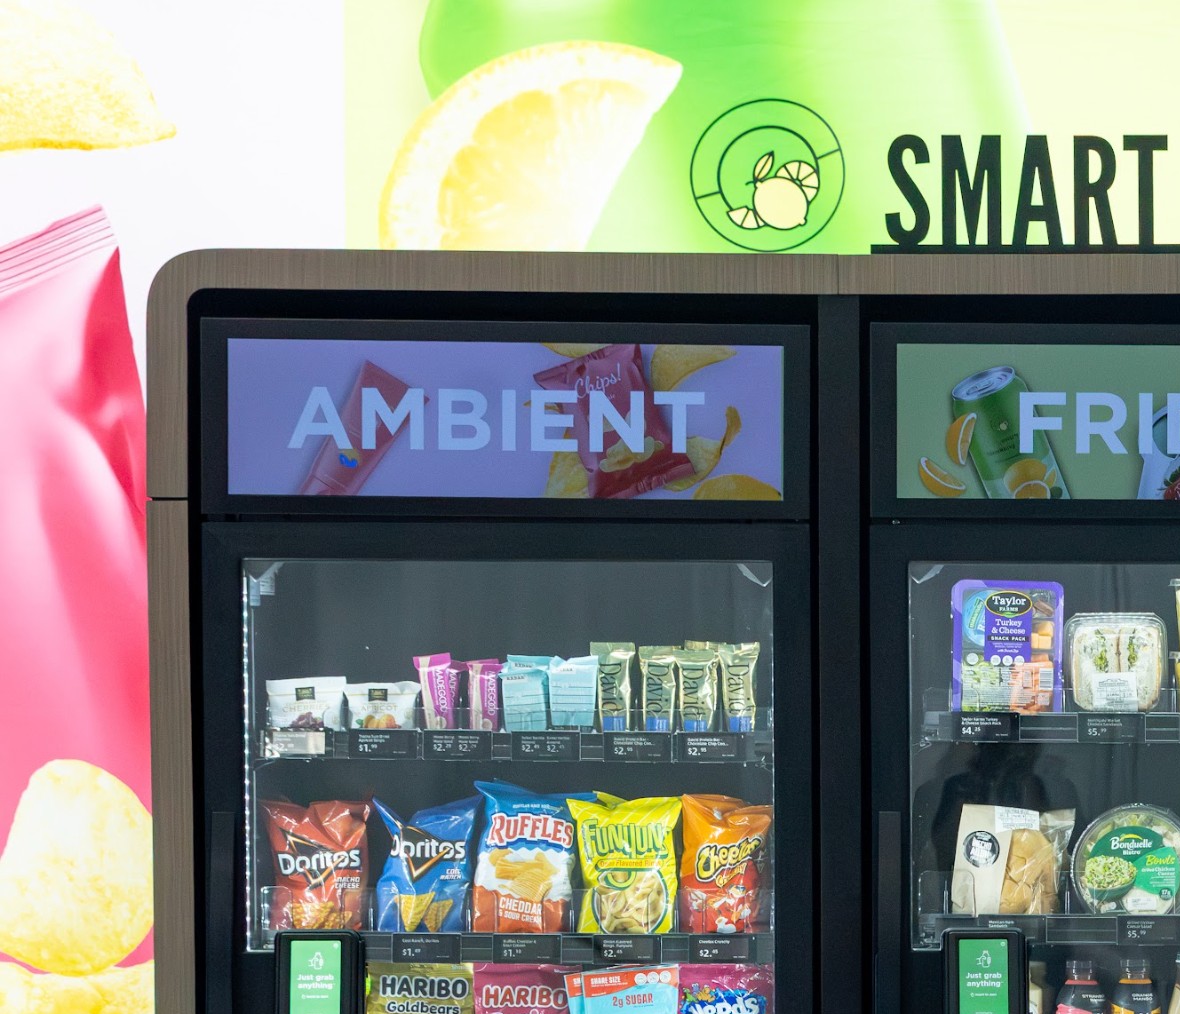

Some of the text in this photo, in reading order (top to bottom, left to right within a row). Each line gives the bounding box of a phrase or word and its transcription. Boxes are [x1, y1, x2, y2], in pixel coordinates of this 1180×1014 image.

[885, 134, 1169, 245] SMART
[287, 387, 705, 454] AMBIENT
[992, 596, 1026, 606] Taylor
[995, 619, 1022, 627] Turkey
[600, 663, 622, 712] David
[647, 664, 669, 713] David
[727, 664, 749, 714] David
[488, 813, 573, 846] RUFFLES
[391, 834, 465, 859] Doritos
[1111, 837, 1152, 850] Bonduelle
[278, 850, 361, 875] Doritos
[696, 837, 762, 882] Cheetos
[1146, 855, 1176, 866] Bowls
[500, 898, 542, 914] CHEDDAR
[504, 910, 520, 920] SOUR
[521, 914, 542, 923] CREAM
[298, 982, 333, 990] anything
[316, 974, 334, 982] grab
[967, 980, 1001, 988] anything
[985, 972, 1002, 980] grab
[380, 975, 468, 999] HARIBO
[482, 984, 567, 1009] HARIBO
[612, 994, 653, 1008] 2g SUGAR
